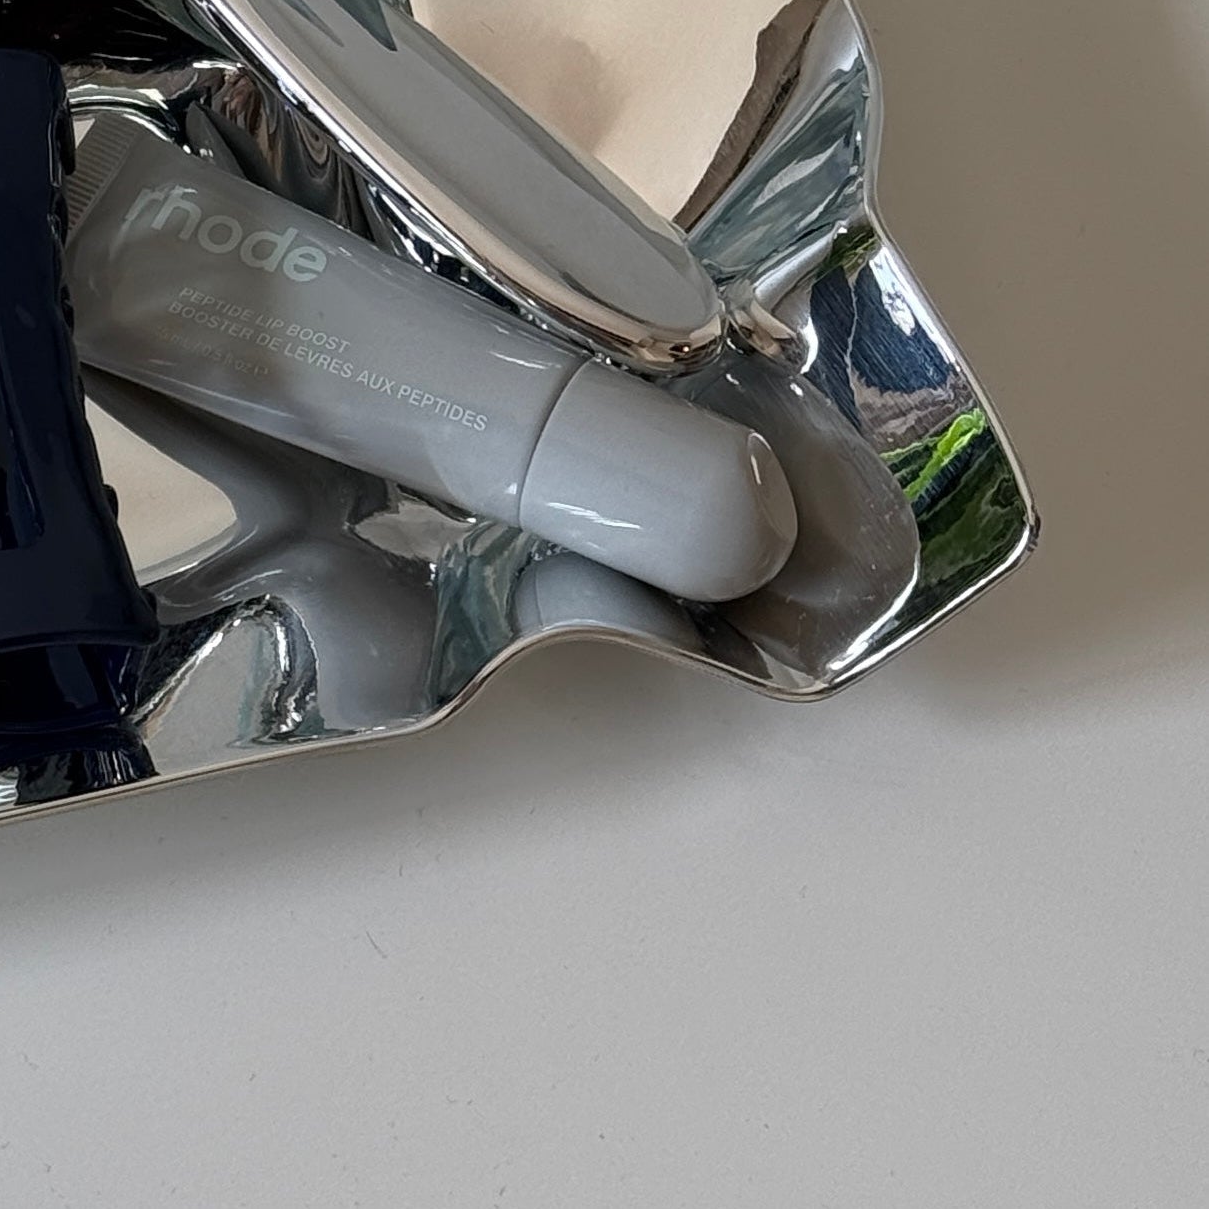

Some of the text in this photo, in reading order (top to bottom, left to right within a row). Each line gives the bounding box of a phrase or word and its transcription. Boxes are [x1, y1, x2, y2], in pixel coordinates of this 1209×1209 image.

[125, 184, 327, 282] rhode
[168, 300, 254, 339] BOOSTER
[256, 333, 283, 351] DE
[356, 370, 395, 395] AUX
[397, 385, 488, 432] PEPTIDES
[179, 287, 350, 353] PEPTIDE LIP BOOST
